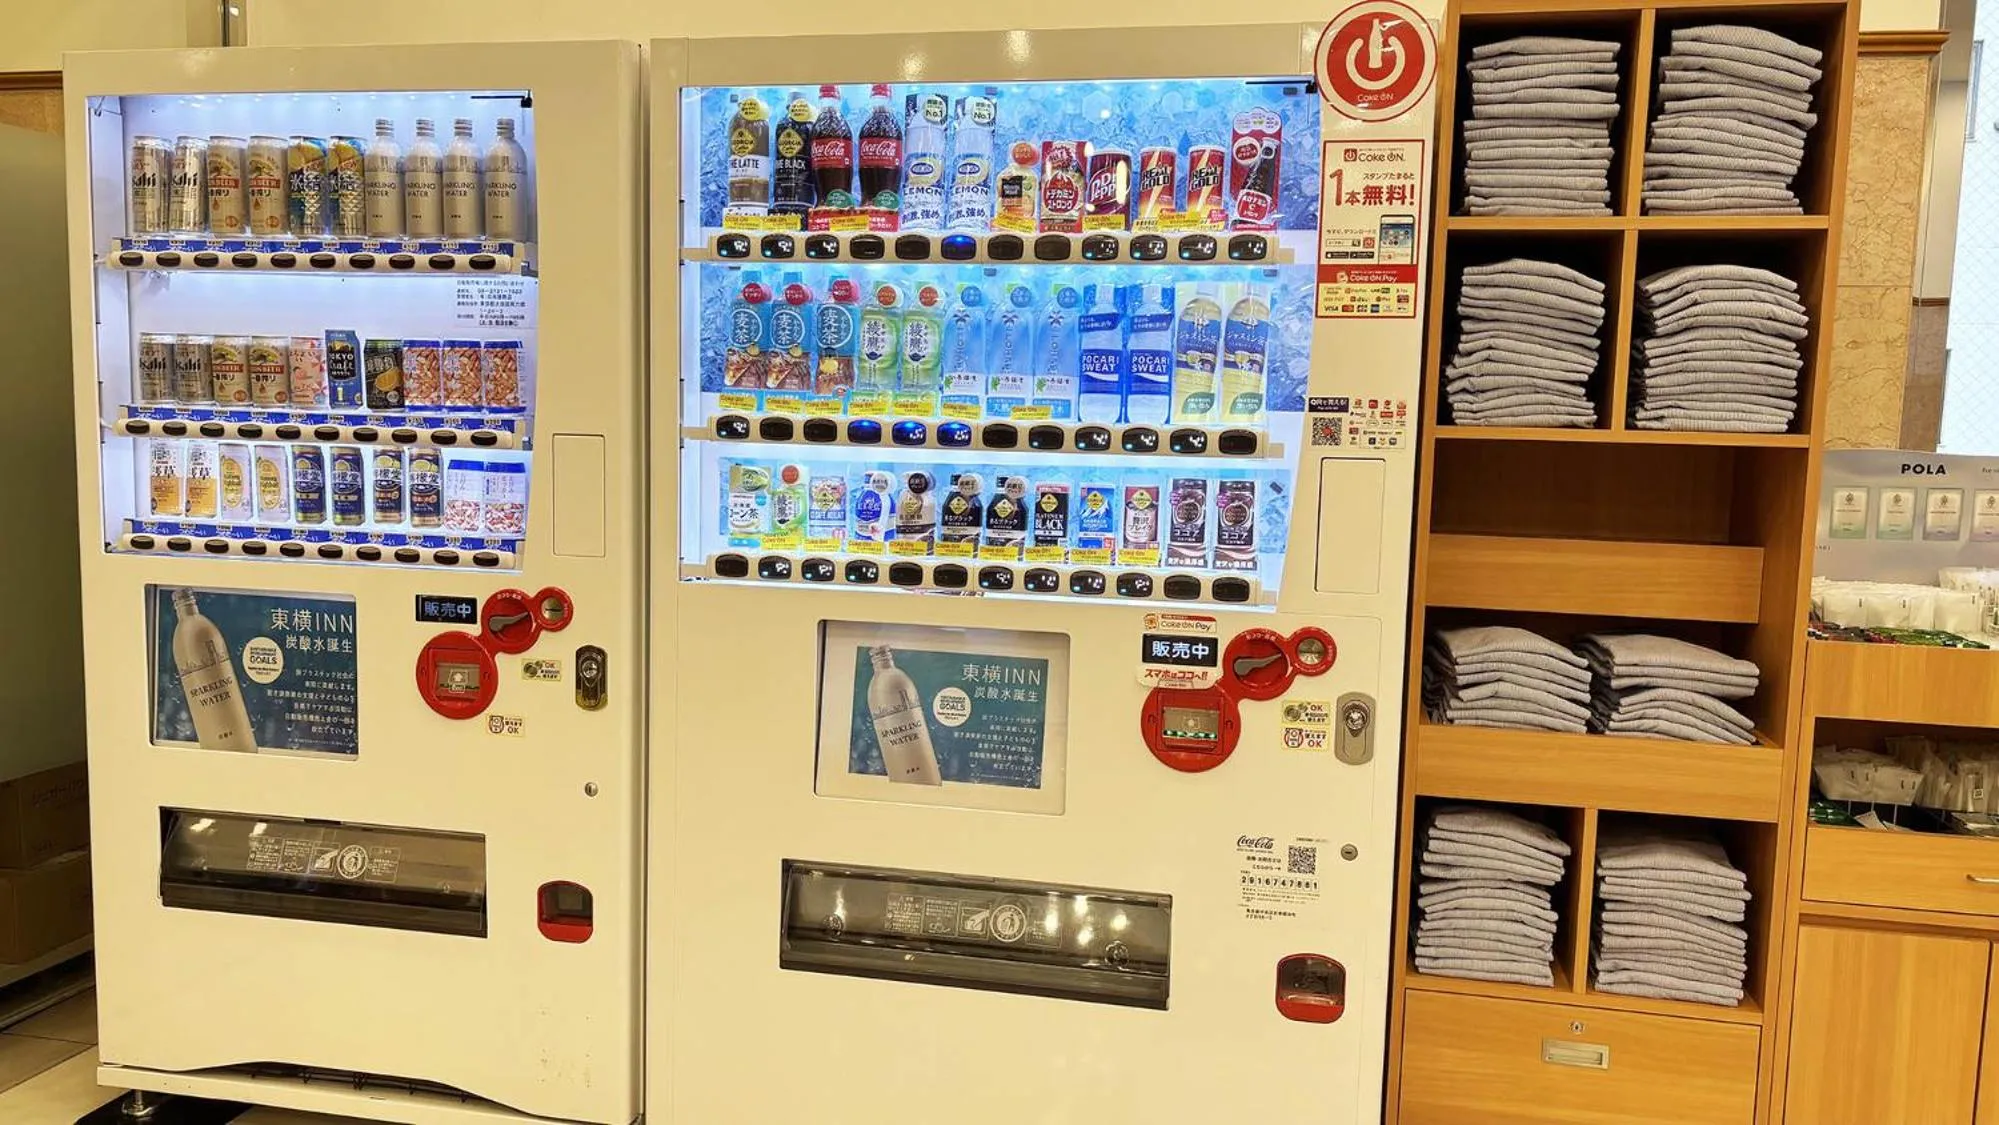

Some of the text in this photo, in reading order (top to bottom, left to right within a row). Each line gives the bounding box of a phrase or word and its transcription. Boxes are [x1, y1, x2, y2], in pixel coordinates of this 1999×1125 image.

[1358, 93, 1394, 102] Coke ON
[1358, 152, 1385, 162] Coke
[740, 159, 760, 169] LATTE
[785, 160, 806, 170] BLACK
[1142, 165, 1170, 180] REAL
[1192, 165, 1219, 180] REAL
[1363, 172, 1415, 181] スタンプたまると
[132, 172, 156, 187] sahi
[1141, 173, 1170, 192] GOLD
[1190, 173, 1219, 192] GOLD
[904, 186, 942, 196] LEMON
[1329, 168, 1415, 206] 1本無料!
[1047, 188, 1075, 199] ドデカミン
[1047, 199, 1072, 209] ストロング
[1350, 274, 1369, 282] Coke
[1383, 274, 1398, 284] Pay
[1082, 355, 1119, 365] POCARI
[1132, 355, 1170, 366] POCARI
[1082, 363, 1115, 372] SWEAT
[1132, 364, 1168, 373] SWEAT
[1901, 463, 1947, 476] POLA
[730, 508, 759, 519] コーン茶
[1035, 519, 1064, 530] BLACK
[1173, 528, 1200, 537] ココア
[1222, 532, 1248, 540] ココア
[424, 601, 472, 619] 販売中
[270, 607, 354, 633] 東横INN
[1161, 620, 1181, 628] Coke
[1195, 622, 1211, 631] Pay
[285, 634, 353, 654] 炭酸水誕生
[1151, 640, 1210, 660] 販売中
[250, 655, 278, 665] GOALS
[962, 663, 1041, 686] 東横INN
[190, 675, 233, 698] SPARKLING
[974, 685, 1039, 703] 炭酸水誕生
[199, 691, 232, 709] WATER
[939, 702, 966, 712] GOALS
[507, 726, 519, 734] OK
[881, 719, 922, 739] SPARKLING
[889, 732, 920, 747] WATER
[1308, 739, 1322, 748] OK
